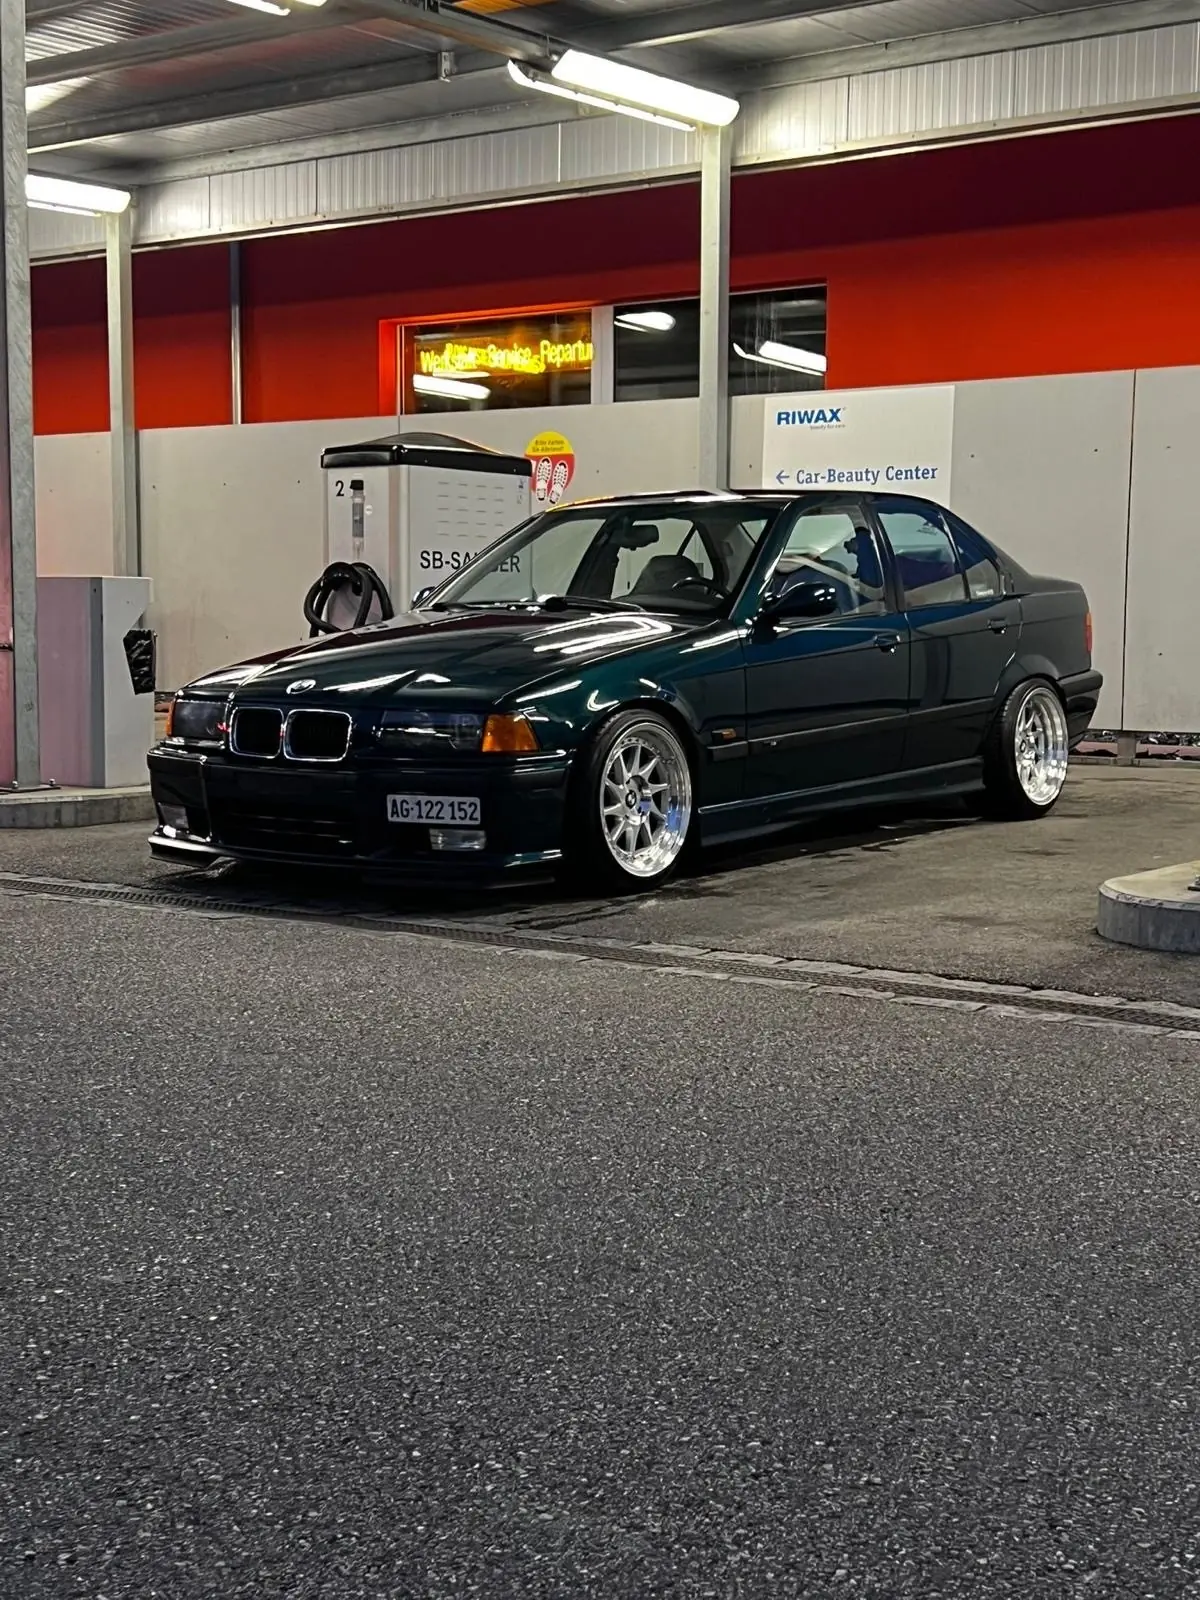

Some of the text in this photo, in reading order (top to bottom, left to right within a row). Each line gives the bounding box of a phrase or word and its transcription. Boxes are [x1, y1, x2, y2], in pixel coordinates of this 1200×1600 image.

[777, 408, 841, 425] RIWAX
[796, 465, 938, 485] Car-Beauty Center
[335, 480, 345, 497] 2
[420, 550, 521, 573] SB-SAER
